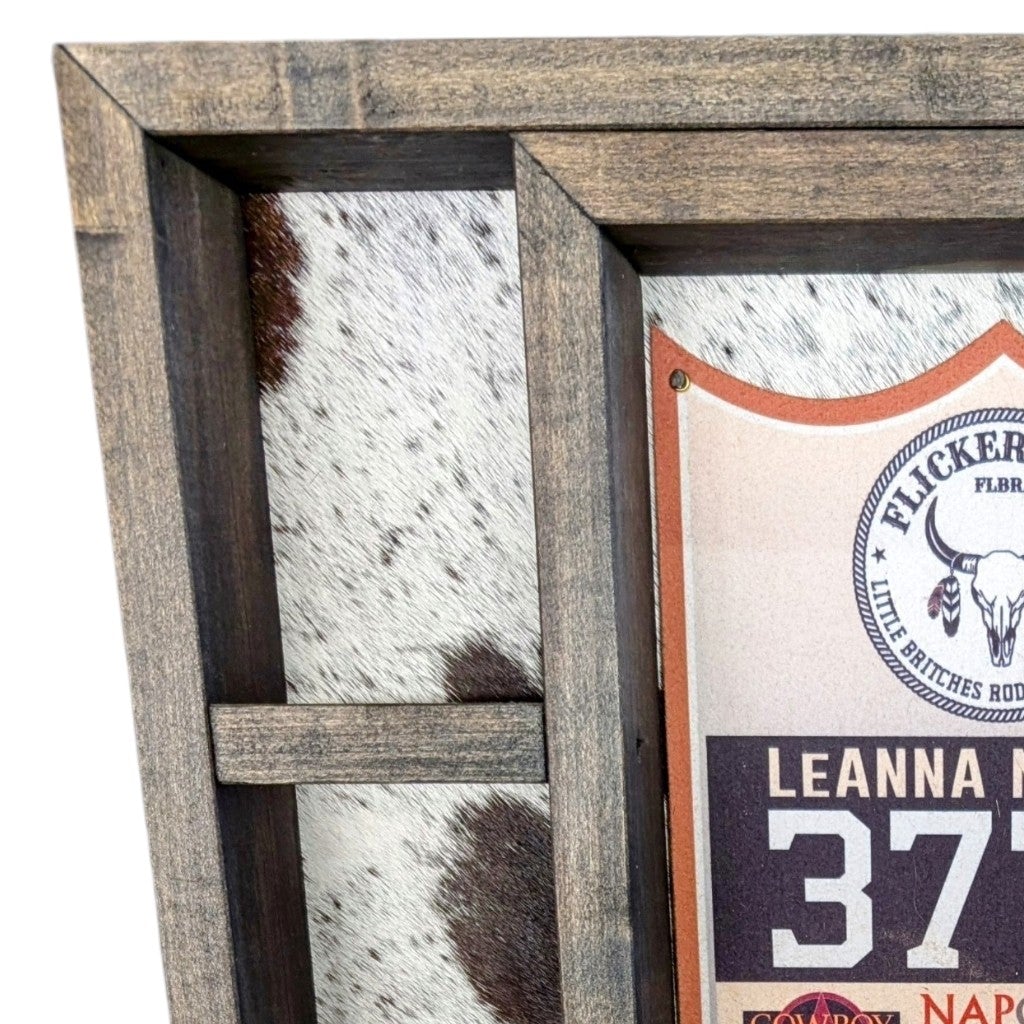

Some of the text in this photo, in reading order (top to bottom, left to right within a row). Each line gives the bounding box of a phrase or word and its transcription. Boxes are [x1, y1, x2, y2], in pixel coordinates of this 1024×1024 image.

[870, 578, 907, 643] LITTLE
[899, 639, 984, 700] BRITCHES
[767, 746, 986, 799] LEANNA
